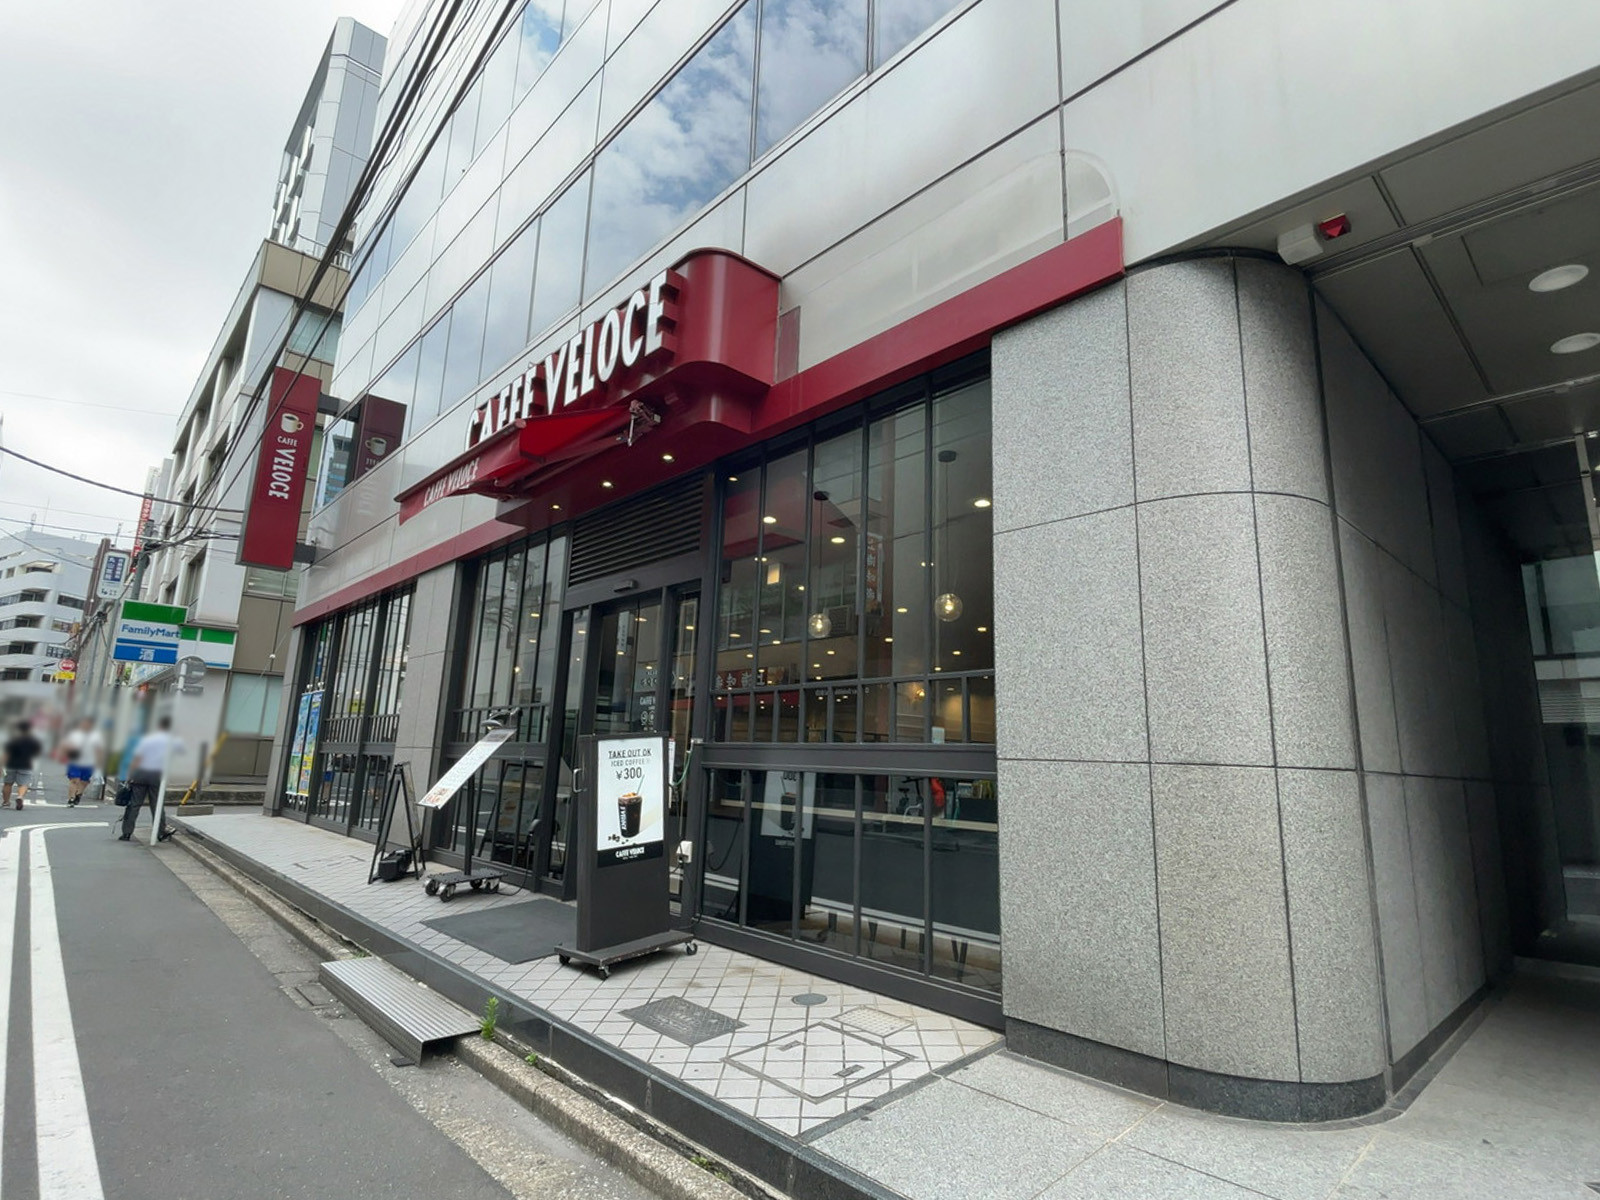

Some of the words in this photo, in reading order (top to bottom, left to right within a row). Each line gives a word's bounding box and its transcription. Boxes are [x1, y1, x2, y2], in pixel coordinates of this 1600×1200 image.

[464, 364, 538, 451] CAFFE
[544, 268, 668, 415] VELOCE
[277, 435, 298, 447] CAFFE
[268, 448, 297, 500] VELOCE
[121, 623, 180, 638] FamilyMart
[138, 648, 155, 662] 酒
[608, 749, 626, 759] TAKE
[627, 748, 641, 758] OUT
[642, 747, 652, 757] OK
[615, 766, 642, 780] ¥300
